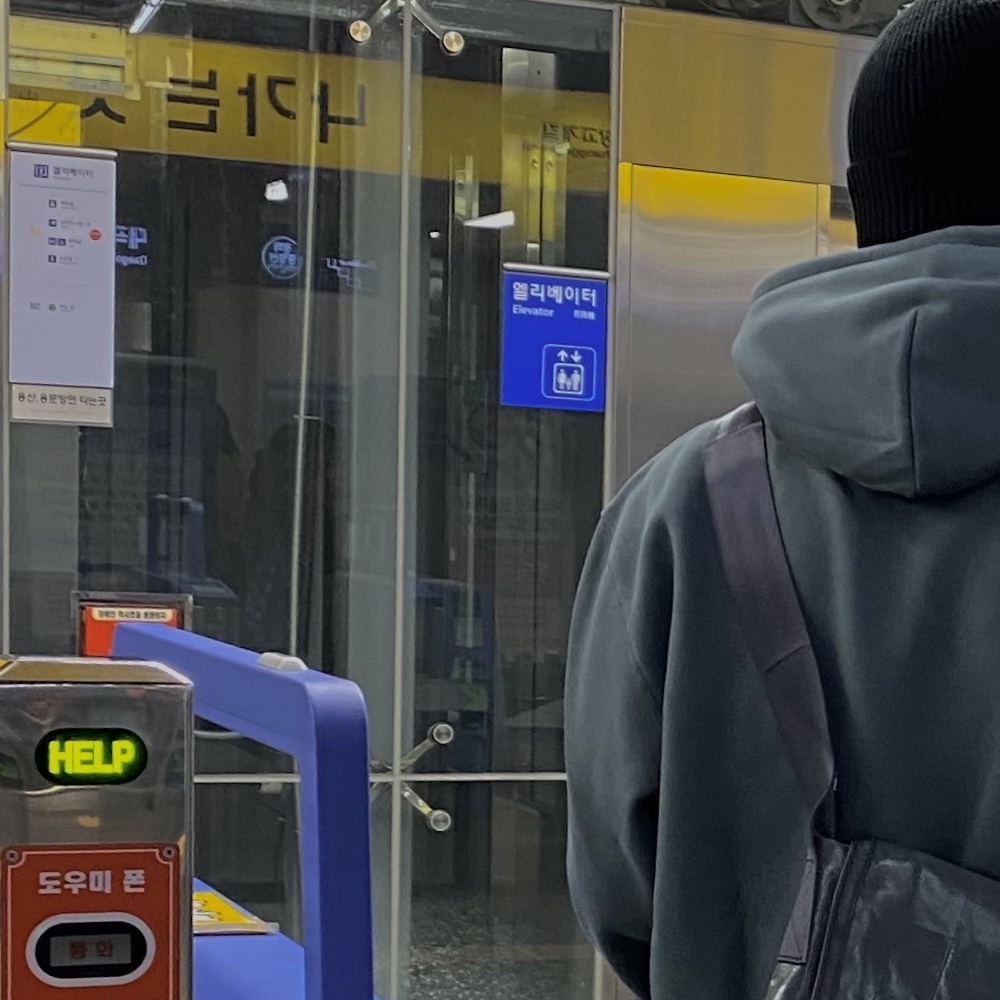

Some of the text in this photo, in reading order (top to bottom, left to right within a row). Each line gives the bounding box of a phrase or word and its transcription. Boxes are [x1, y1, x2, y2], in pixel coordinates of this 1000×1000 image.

[512, 281, 597, 307] 엘리베이터
[512, 304, 554, 317] Elevator
[80, 396, 106, 407] 타는곳
[48, 740, 136, 775] HELP
[38, 869, 146, 895] 도우미 폰
